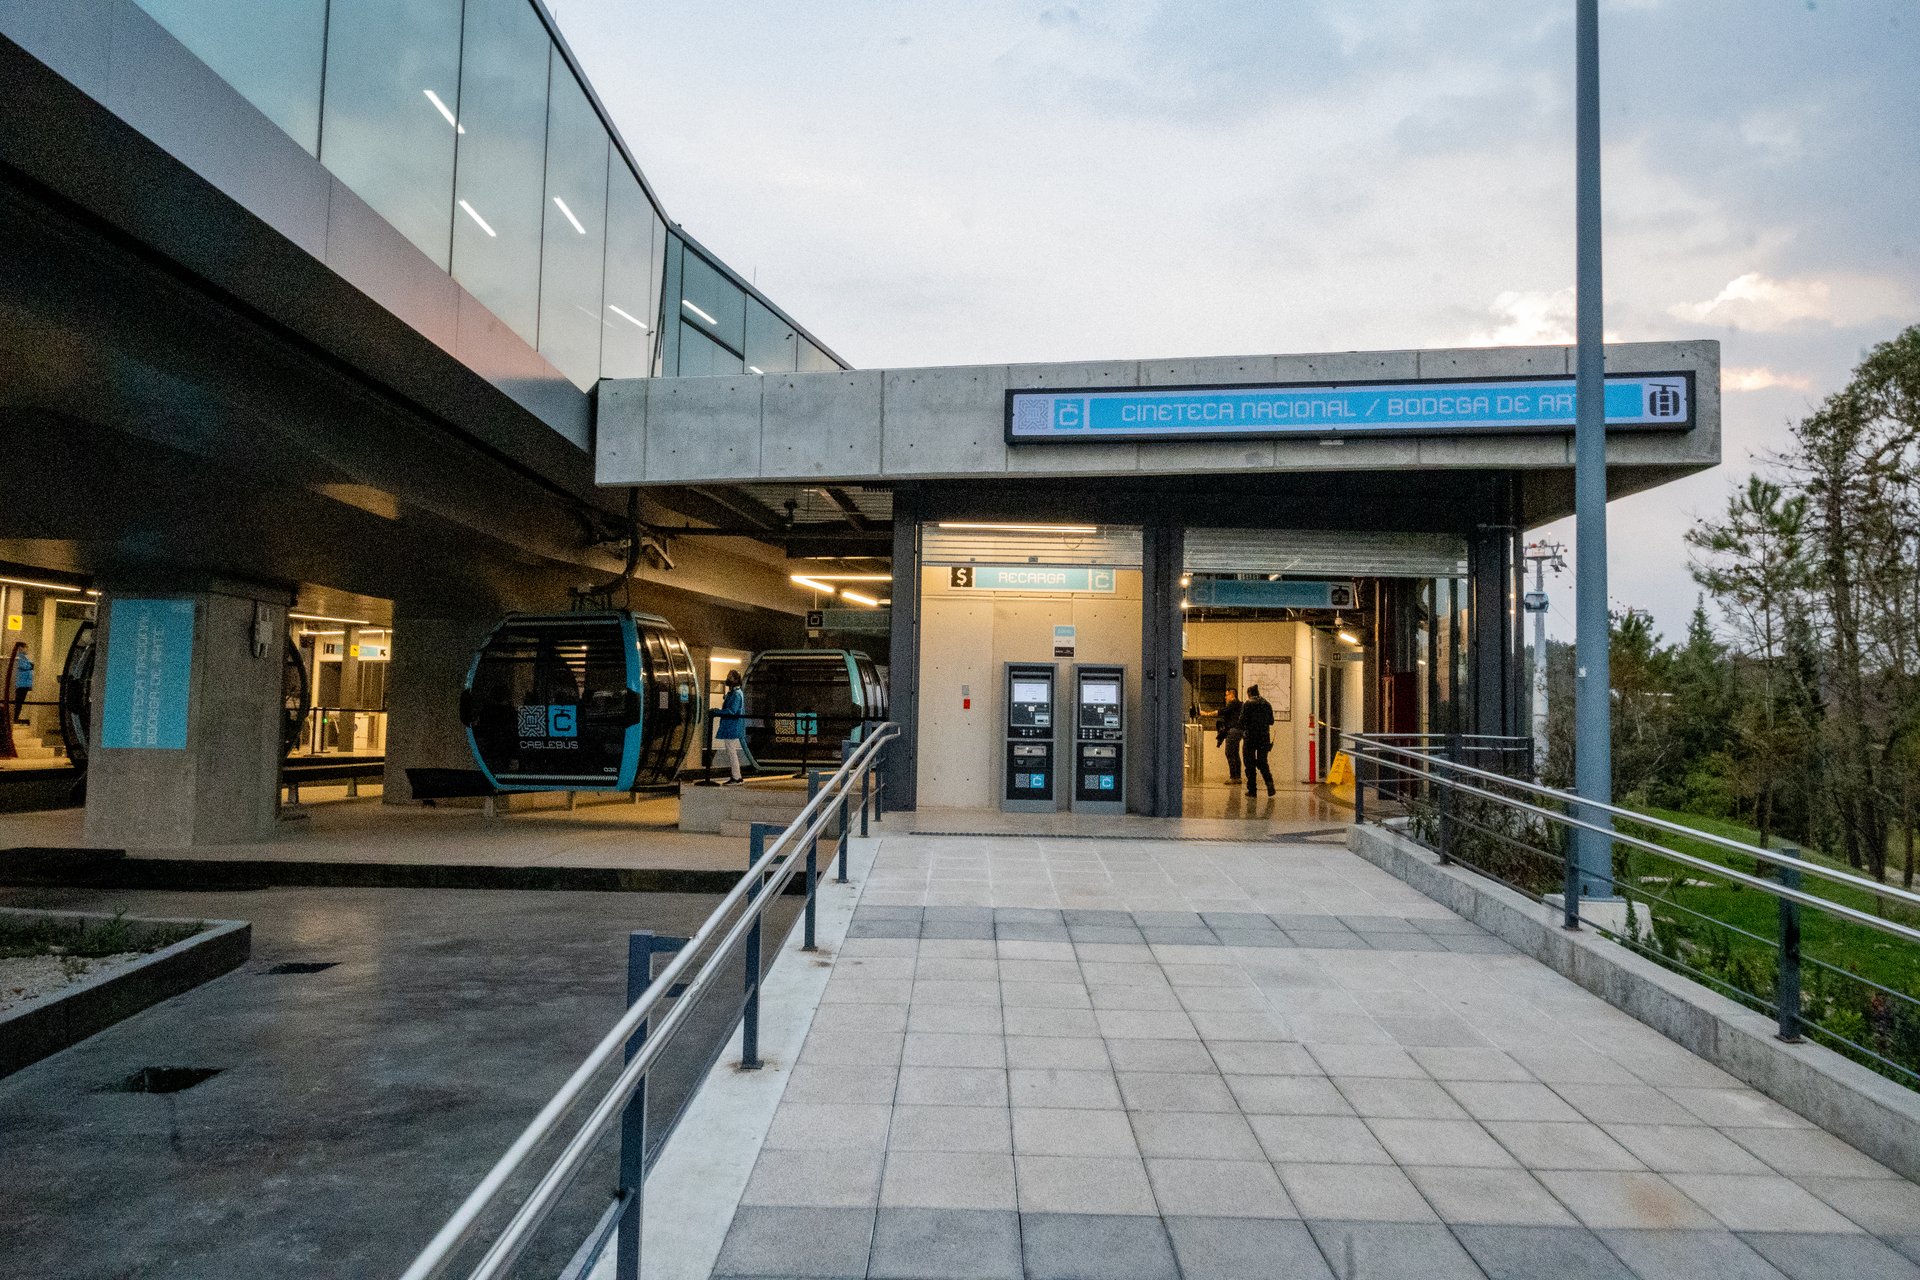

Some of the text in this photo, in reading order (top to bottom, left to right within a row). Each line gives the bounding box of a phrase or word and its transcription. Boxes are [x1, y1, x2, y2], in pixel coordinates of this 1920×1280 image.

[1122, 402, 1234, 422] CINETECA
[1240, 399, 1357, 419] NACIONAL
[1387, 395, 1489, 416] BODEGA
[1496, 394, 1530, 414] DE
[1538, 393, 1576, 412] AR
[998, 571, 1066, 584] RECARGA
